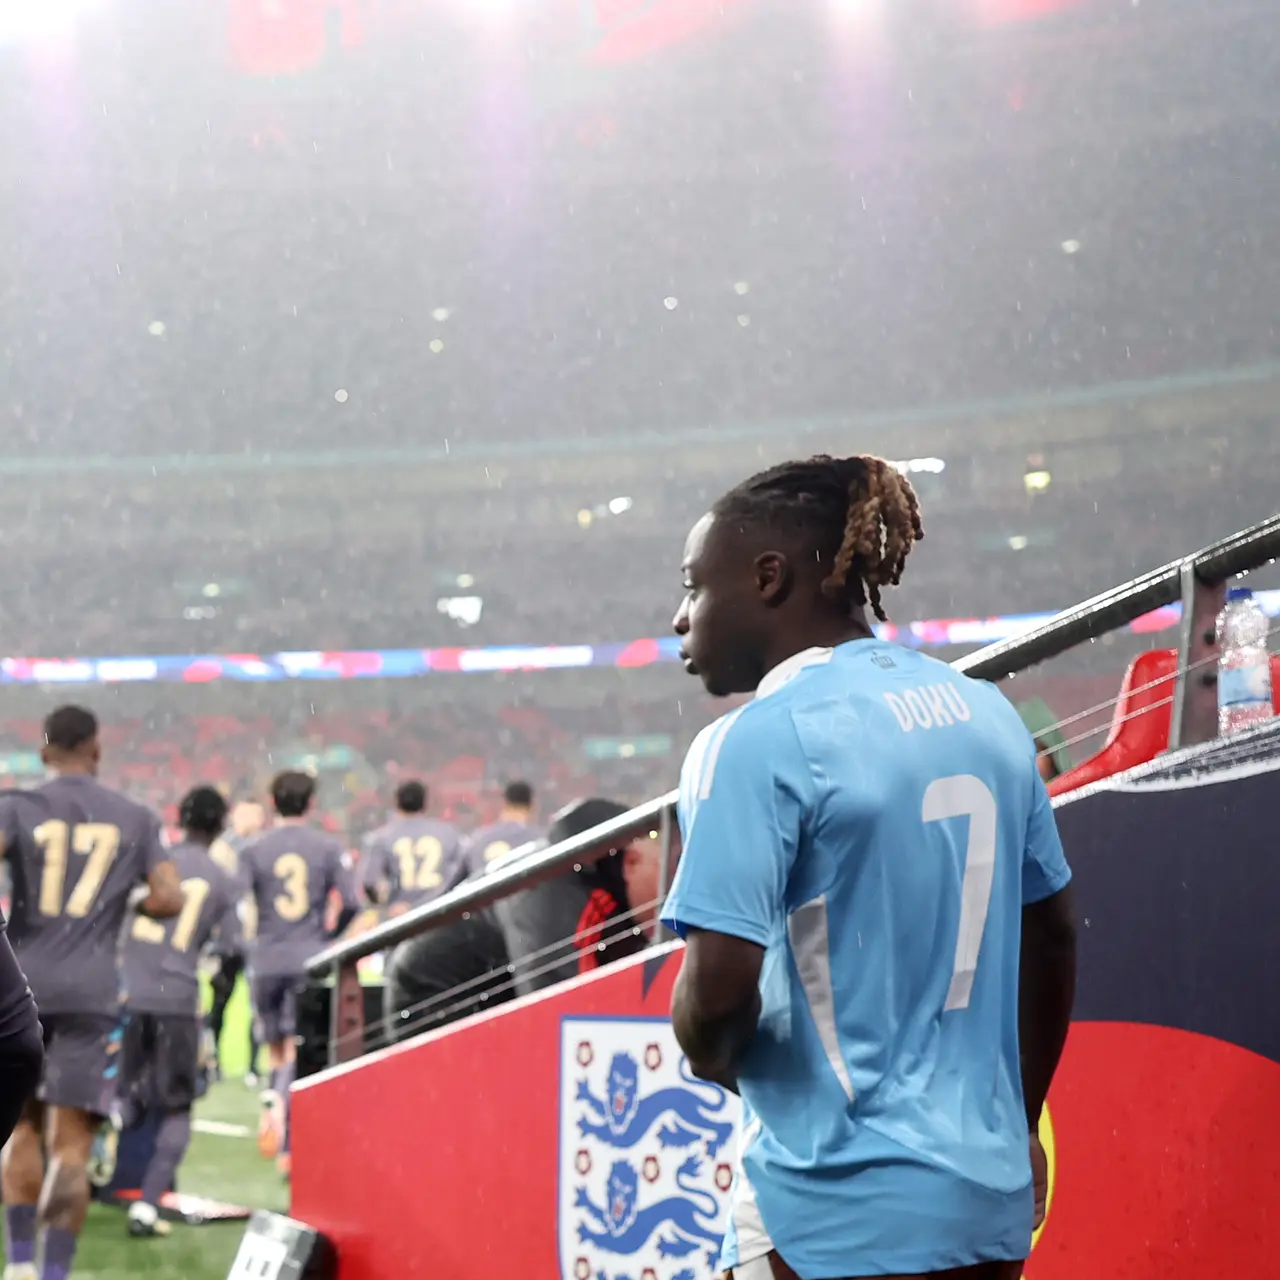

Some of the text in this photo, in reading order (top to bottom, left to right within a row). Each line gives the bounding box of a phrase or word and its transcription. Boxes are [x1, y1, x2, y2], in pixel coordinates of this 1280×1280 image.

[883, 682, 971, 732] DOKU
[34, 819, 121, 918] 17
[273, 852, 309, 922] 3
[394, 835, 443, 889] 12
[922, 773, 997, 1012] 7
